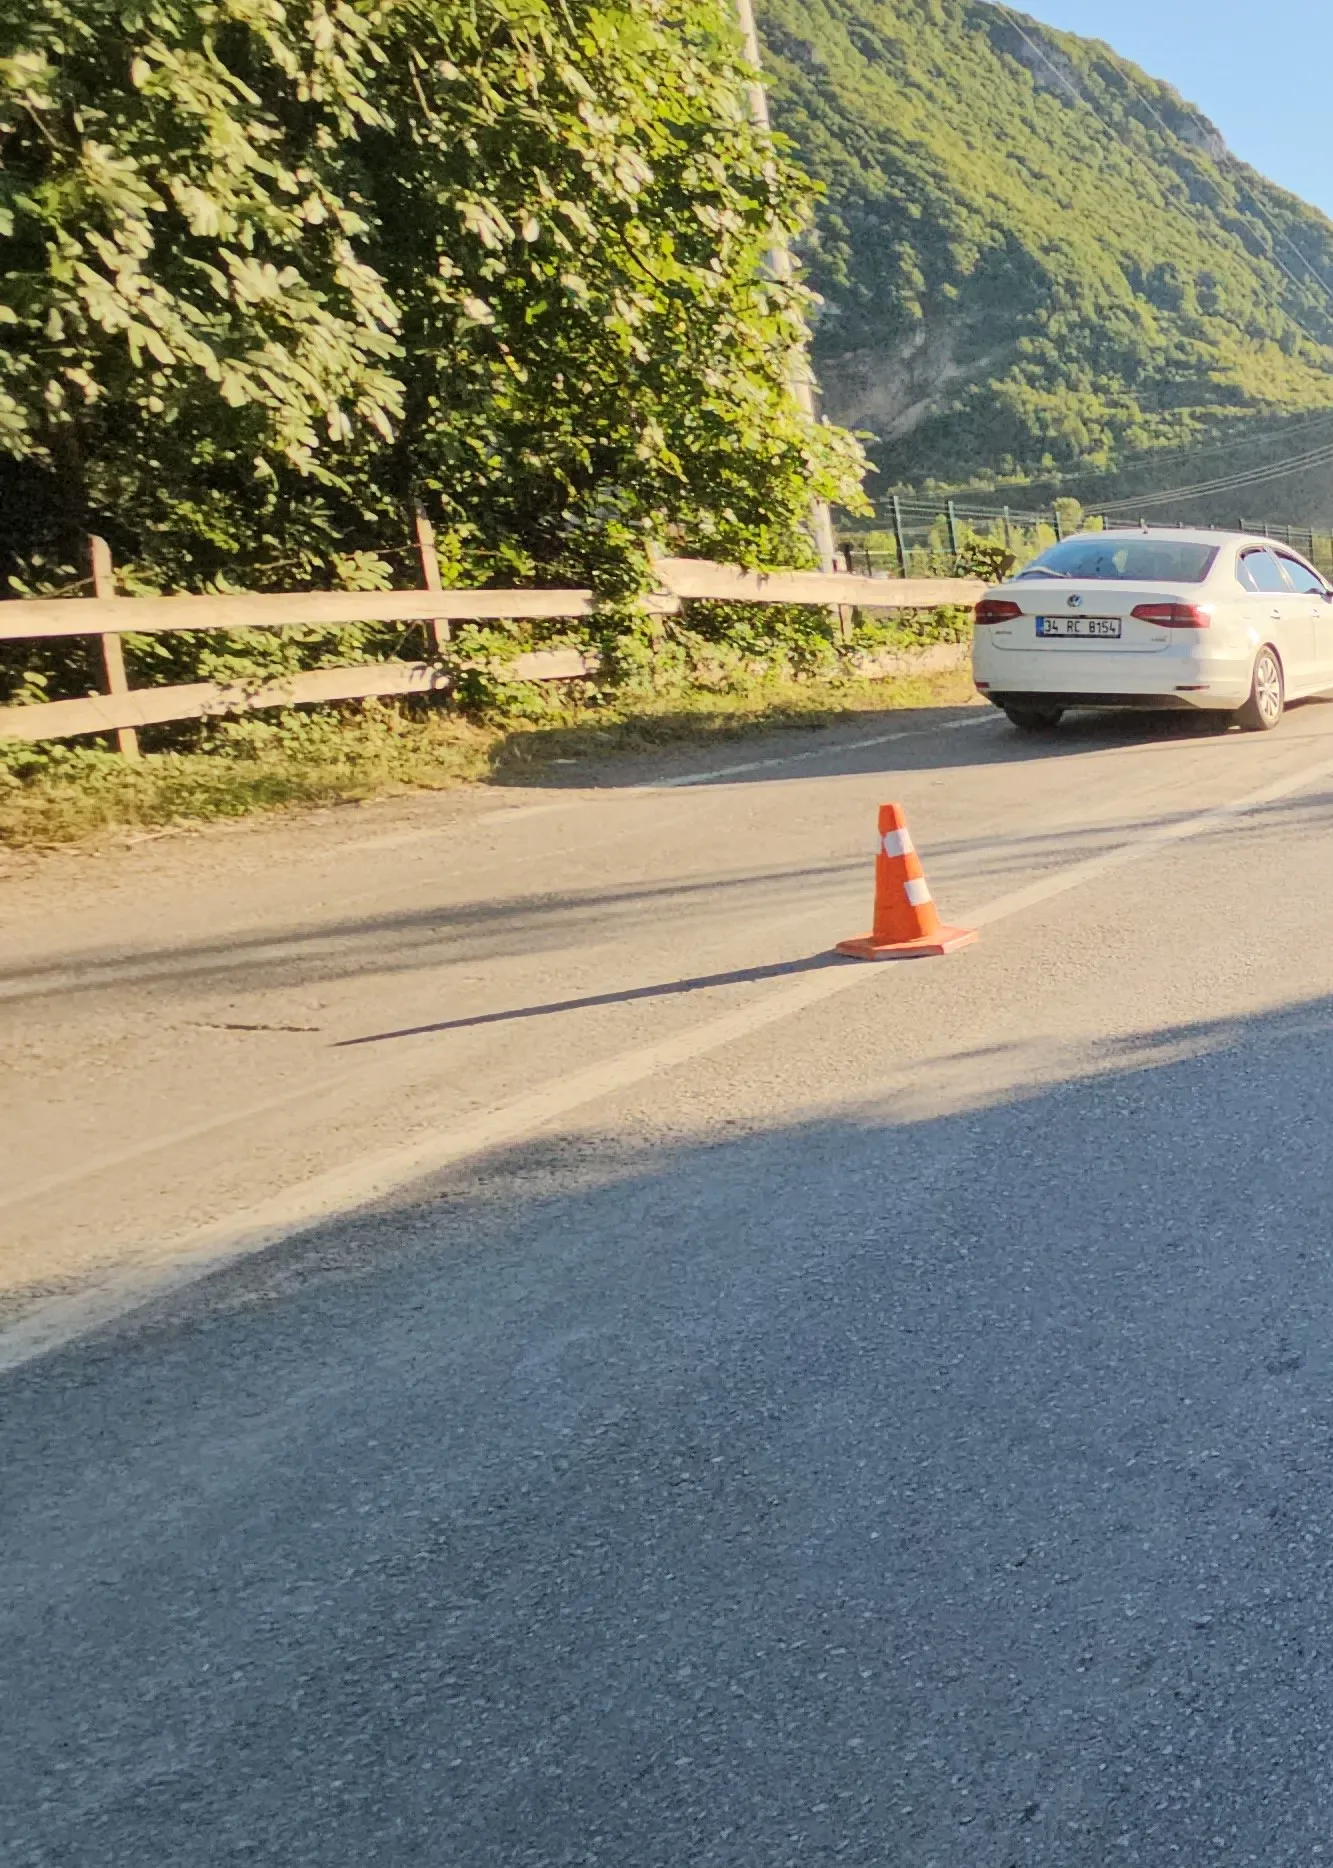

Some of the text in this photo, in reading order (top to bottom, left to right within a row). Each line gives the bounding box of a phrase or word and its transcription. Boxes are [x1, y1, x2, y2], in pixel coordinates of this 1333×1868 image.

[1044, 620, 1116, 634] 34 RC 8154
